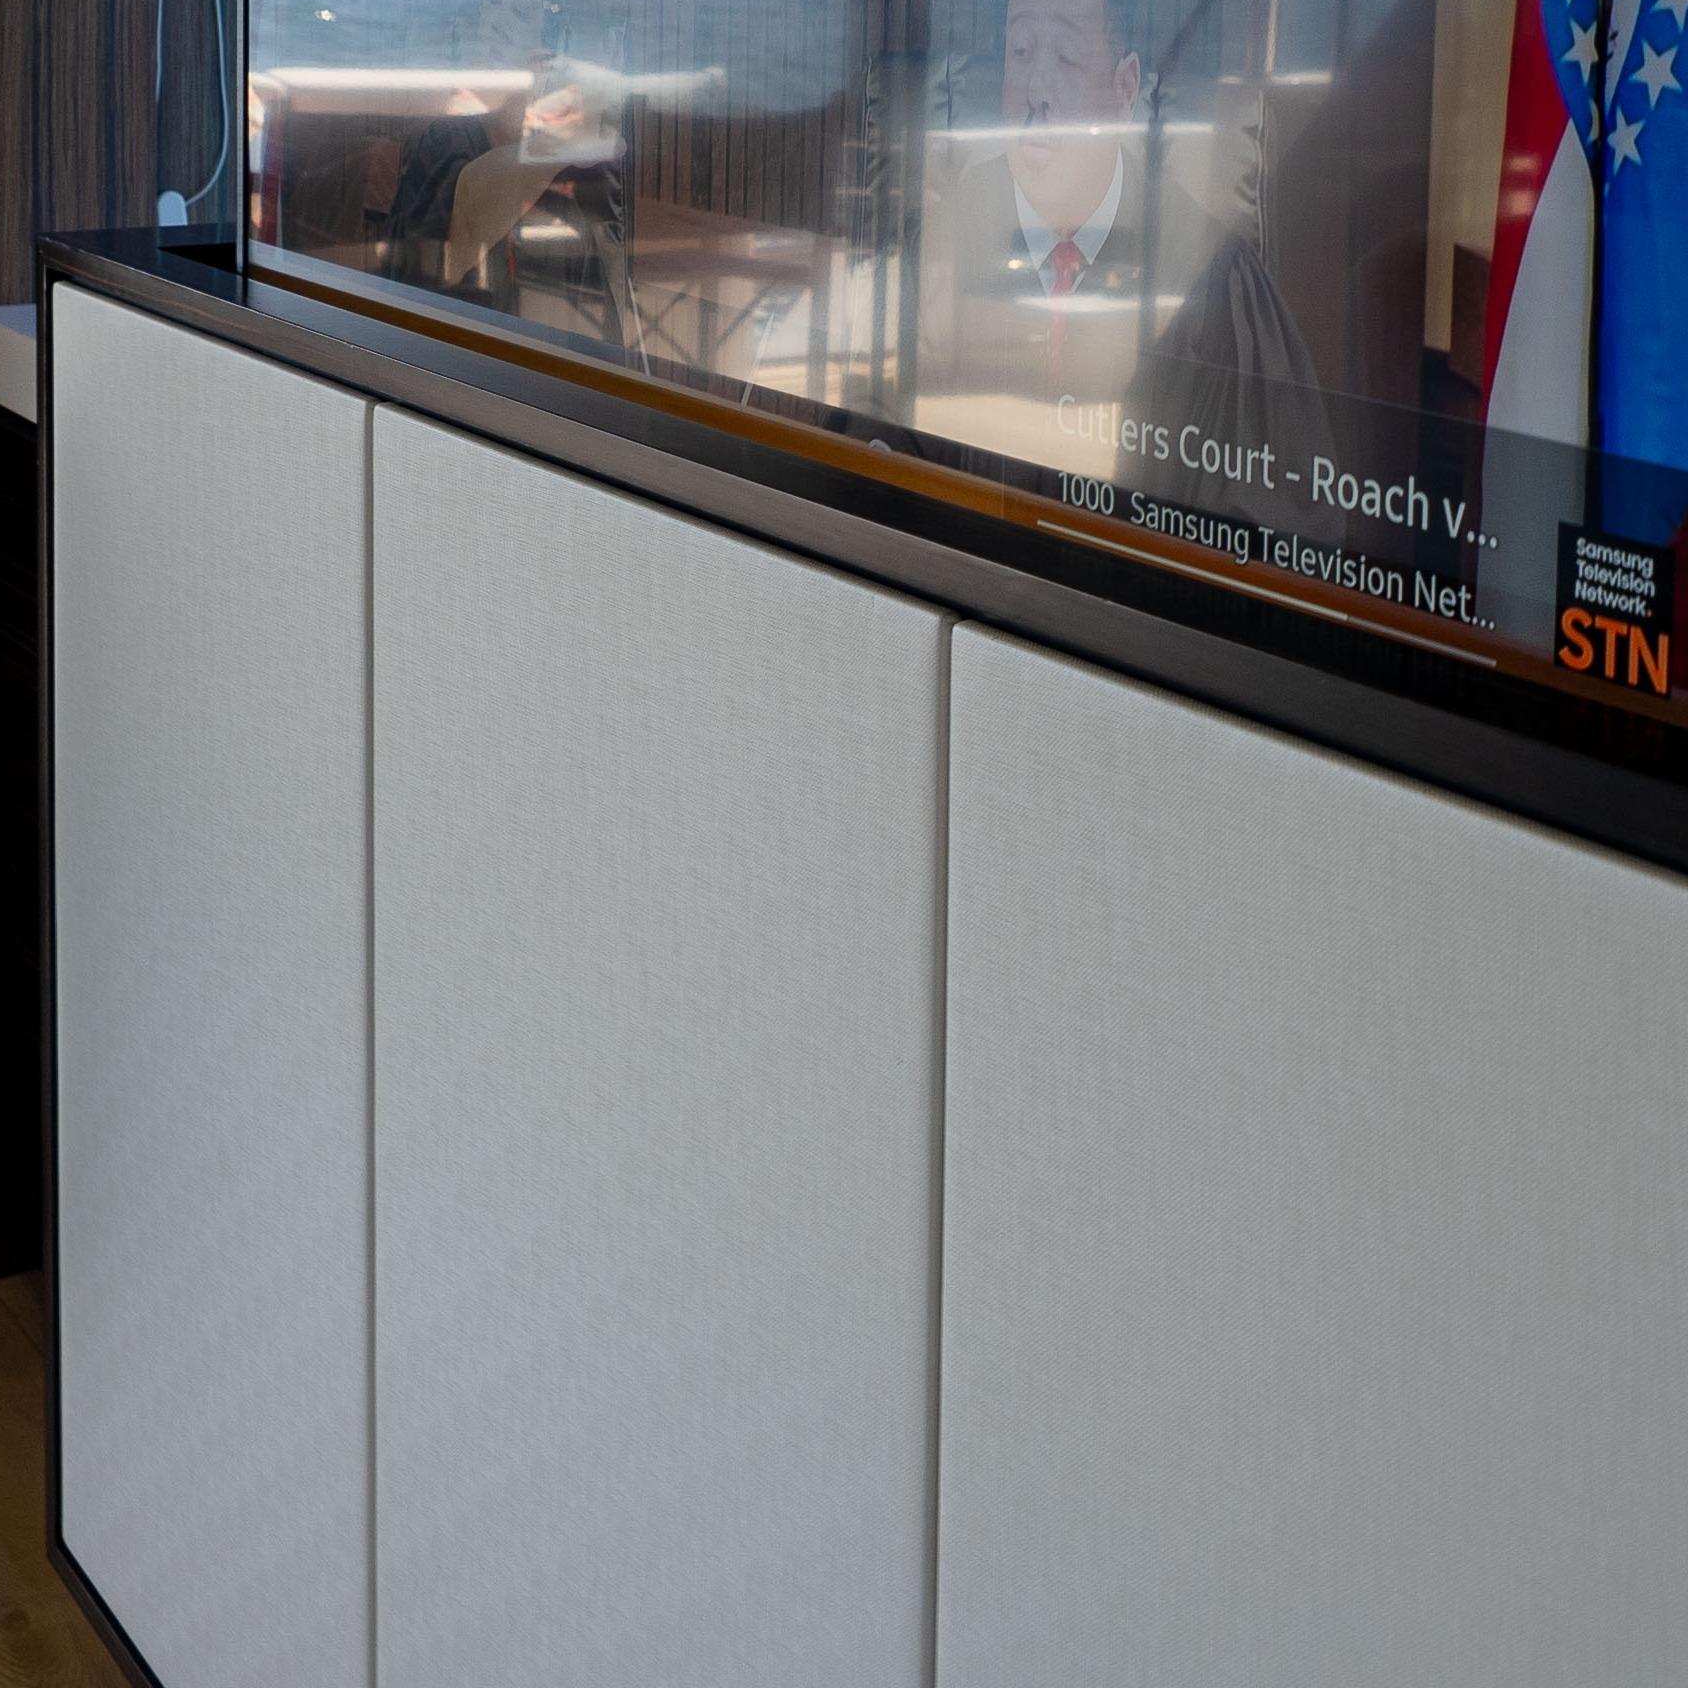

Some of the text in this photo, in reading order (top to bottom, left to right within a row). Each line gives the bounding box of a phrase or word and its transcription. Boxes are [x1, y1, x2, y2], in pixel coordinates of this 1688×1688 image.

[1057, 394, 1497, 549] Cutlers Court - Roach v...
[1058, 472, 1495, 630] 1000 Samsung Television Net...
[1576, 537, 1654, 579] Samsung
[1576, 560, 1655, 598] Television
[1559, 606, 1669, 695] STN
